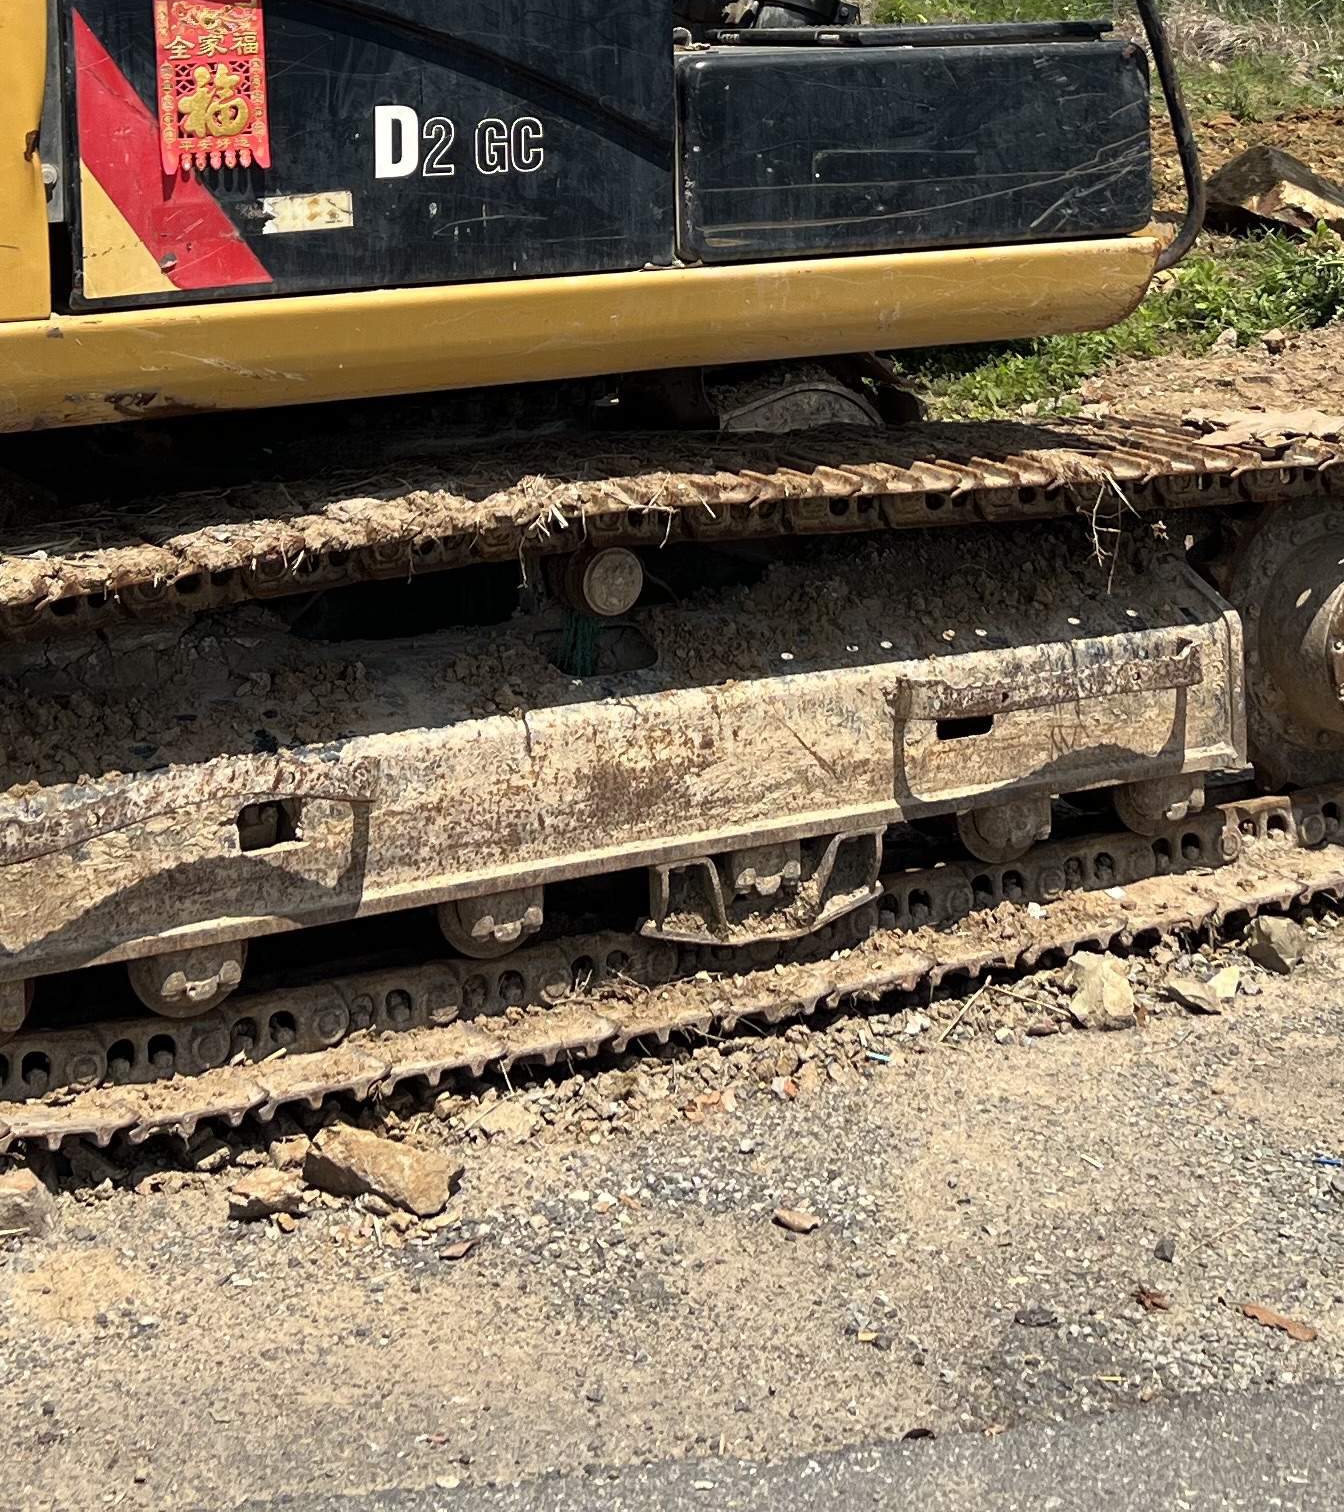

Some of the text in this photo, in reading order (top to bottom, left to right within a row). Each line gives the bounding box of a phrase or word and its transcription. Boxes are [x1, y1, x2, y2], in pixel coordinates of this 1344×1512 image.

[163, 31, 260, 60] 全家福
[177, 62, 249, 138] 福
[374, 104, 544, 179] D2 GC
